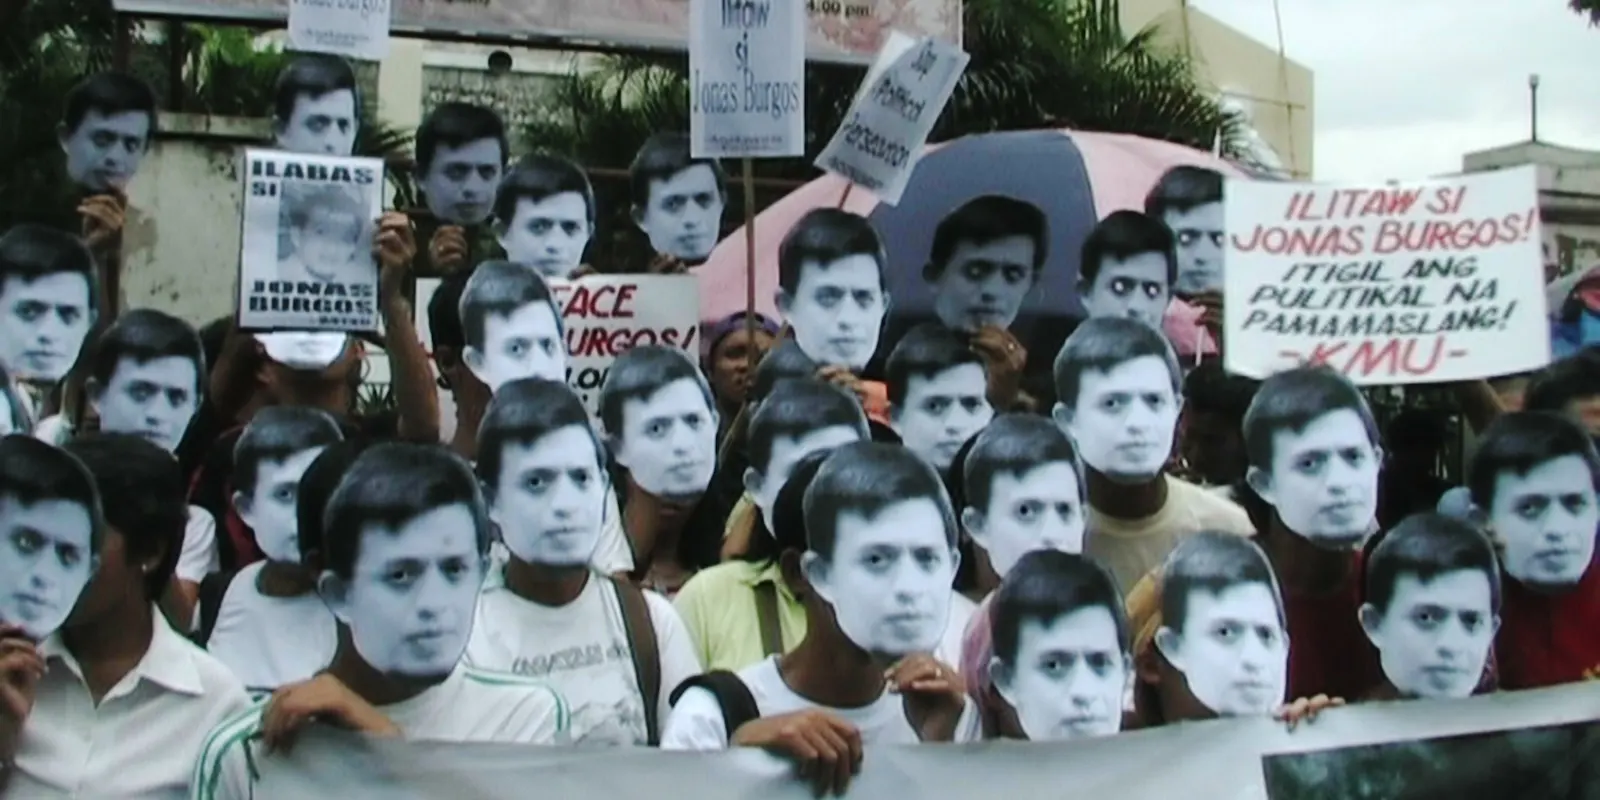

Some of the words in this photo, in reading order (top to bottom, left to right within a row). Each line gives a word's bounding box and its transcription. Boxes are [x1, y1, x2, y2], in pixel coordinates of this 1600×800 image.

[694, 69, 738, 114] Jonas
[744, 68, 799, 120] Burgos
[252, 160, 374, 184] ILABAS
[252, 182, 277, 197] SI
[1284, 187, 1421, 221] ILITAW
[1425, 186, 1467, 214] SI
[1231, 223, 1365, 256] JONAS
[1374, 207, 1536, 256] BURGOS!
[1281, 260, 1393, 283] ITIGIL
[1403, 257, 1478, 279] ANG
[252, 280, 374, 298] JONAS
[1248, 284, 1436, 310] PULITIKAL
[1444, 279, 1498, 305] NA
[248, 297, 374, 315] BURGOS
[1241, 300, 1517, 338] PAMAMASLANG!
[565, 325, 697, 358] URGOS!
